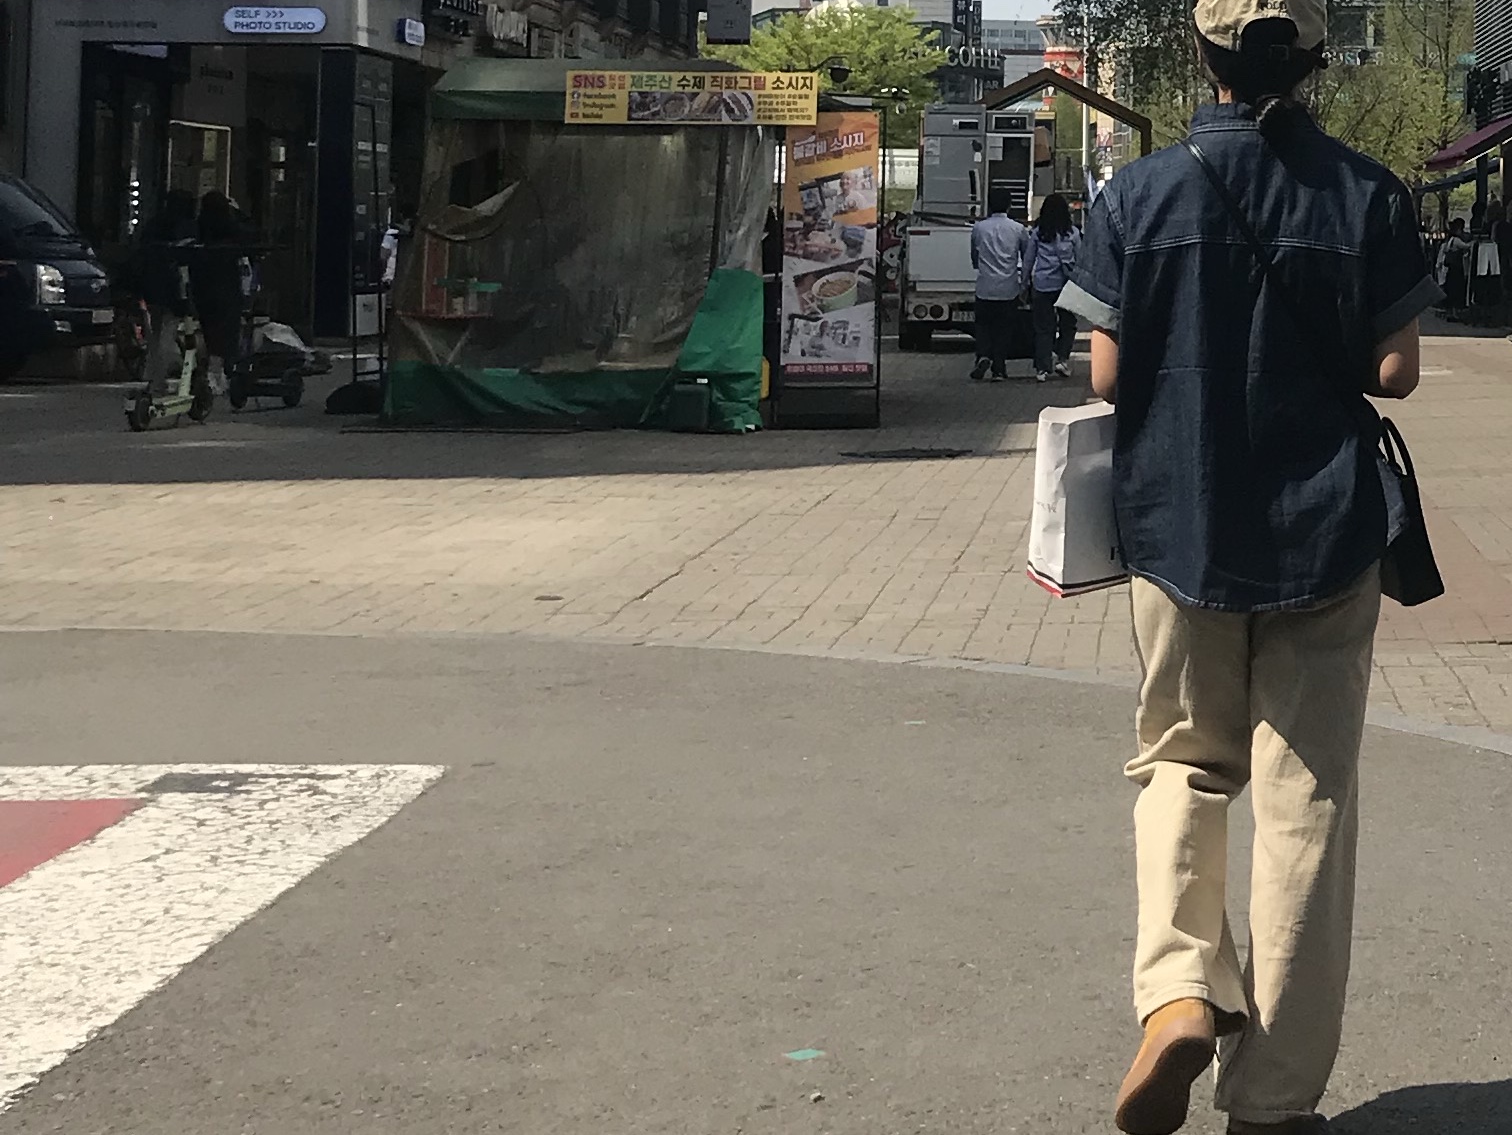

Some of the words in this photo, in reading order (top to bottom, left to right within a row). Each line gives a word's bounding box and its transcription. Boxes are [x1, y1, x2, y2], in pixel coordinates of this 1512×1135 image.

[234, 10, 261, 20] SELF
[233, 20, 273, 31] PHOTO
[275, 20, 316, 31] STUDIO
[572, 74, 606, 90] SNS
[630, 74, 674, 91] 제주산
[676, 75, 706, 91] 수제
[710, 75, 767, 91] 직화그릴
[771, 75, 814, 91] 소시지
[830, 131, 865, 153] 소시지
